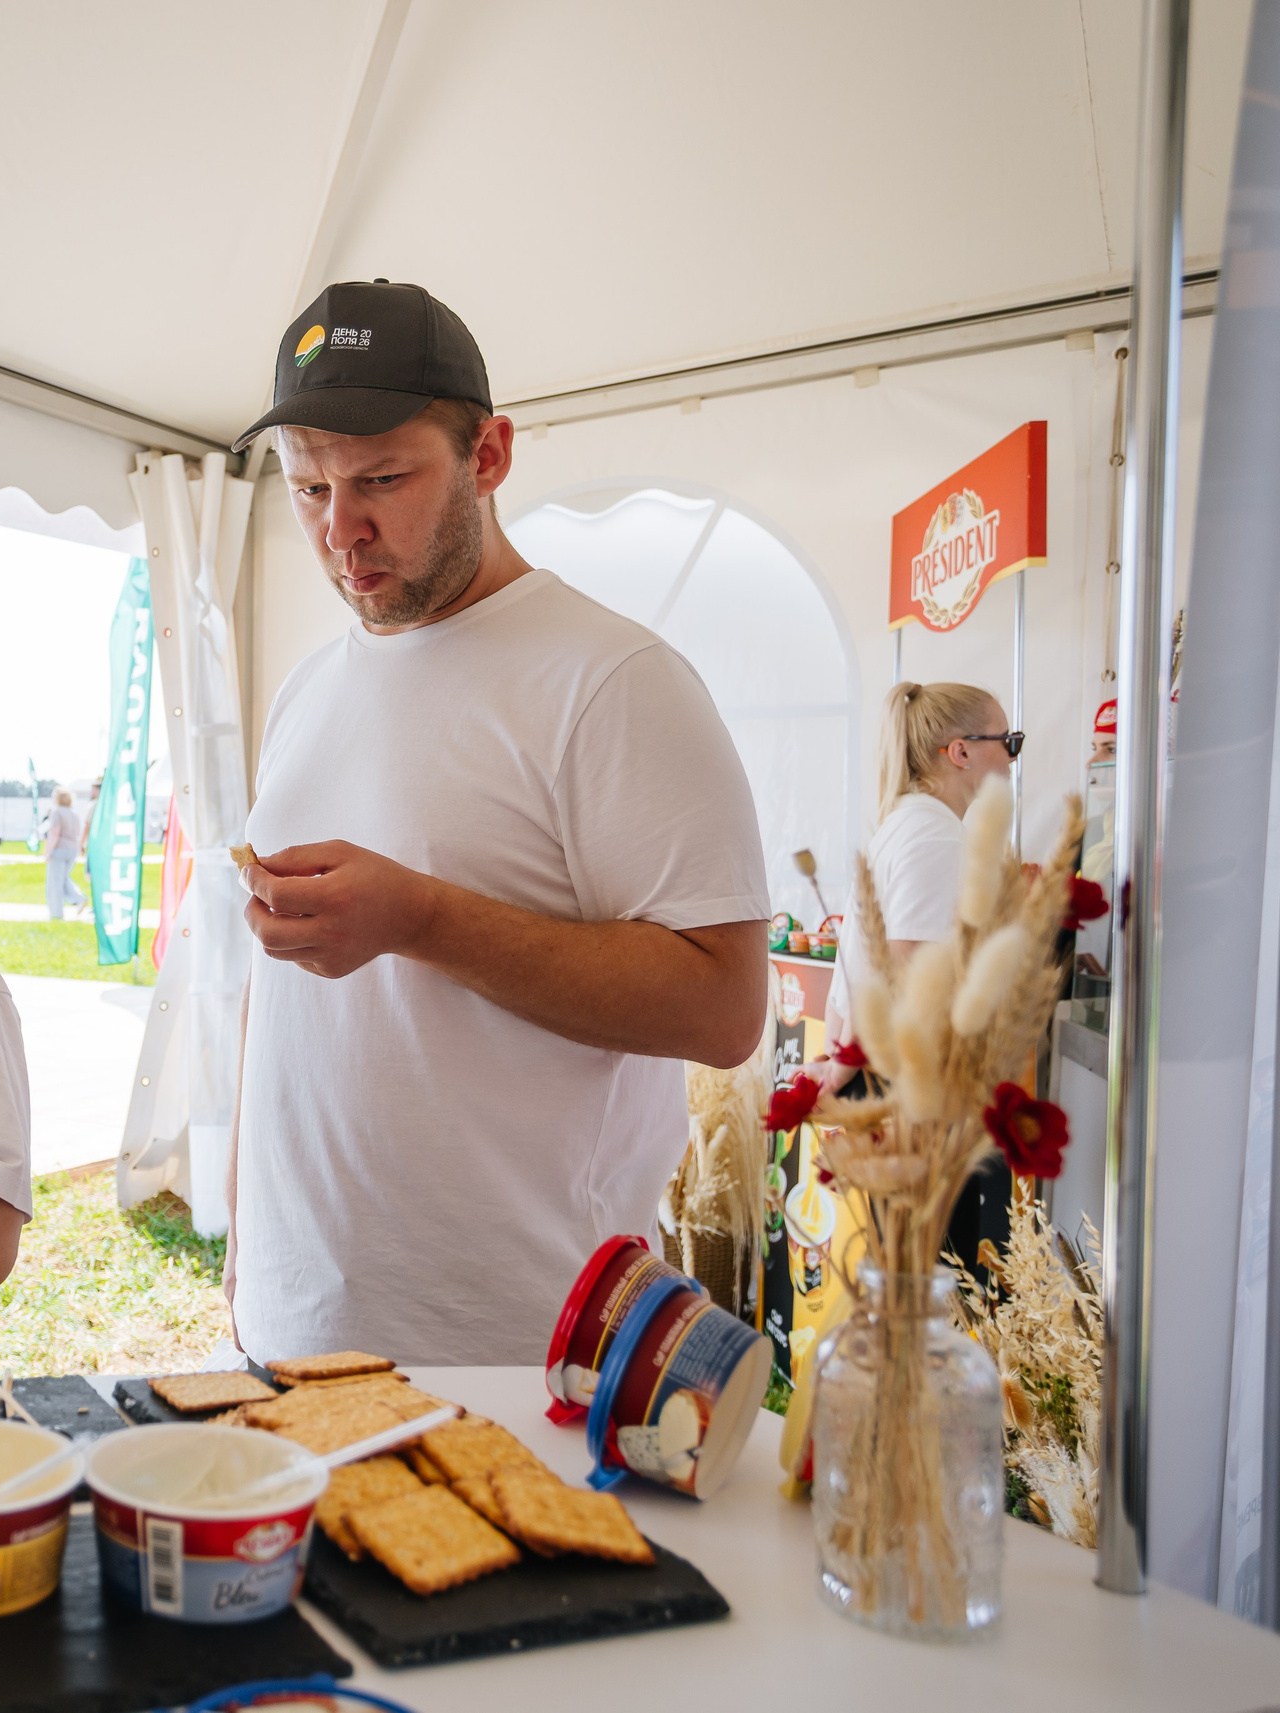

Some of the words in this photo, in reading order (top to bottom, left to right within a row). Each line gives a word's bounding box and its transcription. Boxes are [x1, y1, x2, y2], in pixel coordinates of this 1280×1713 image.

[332, 328, 358, 337] ДЕНЬ
[360, 329, 372, 338] 20
[330, 336, 358, 345] ПОЛЯ
[358, 338, 370, 347] 26
[913, 515, 999, 597] PRÉSIDENT
